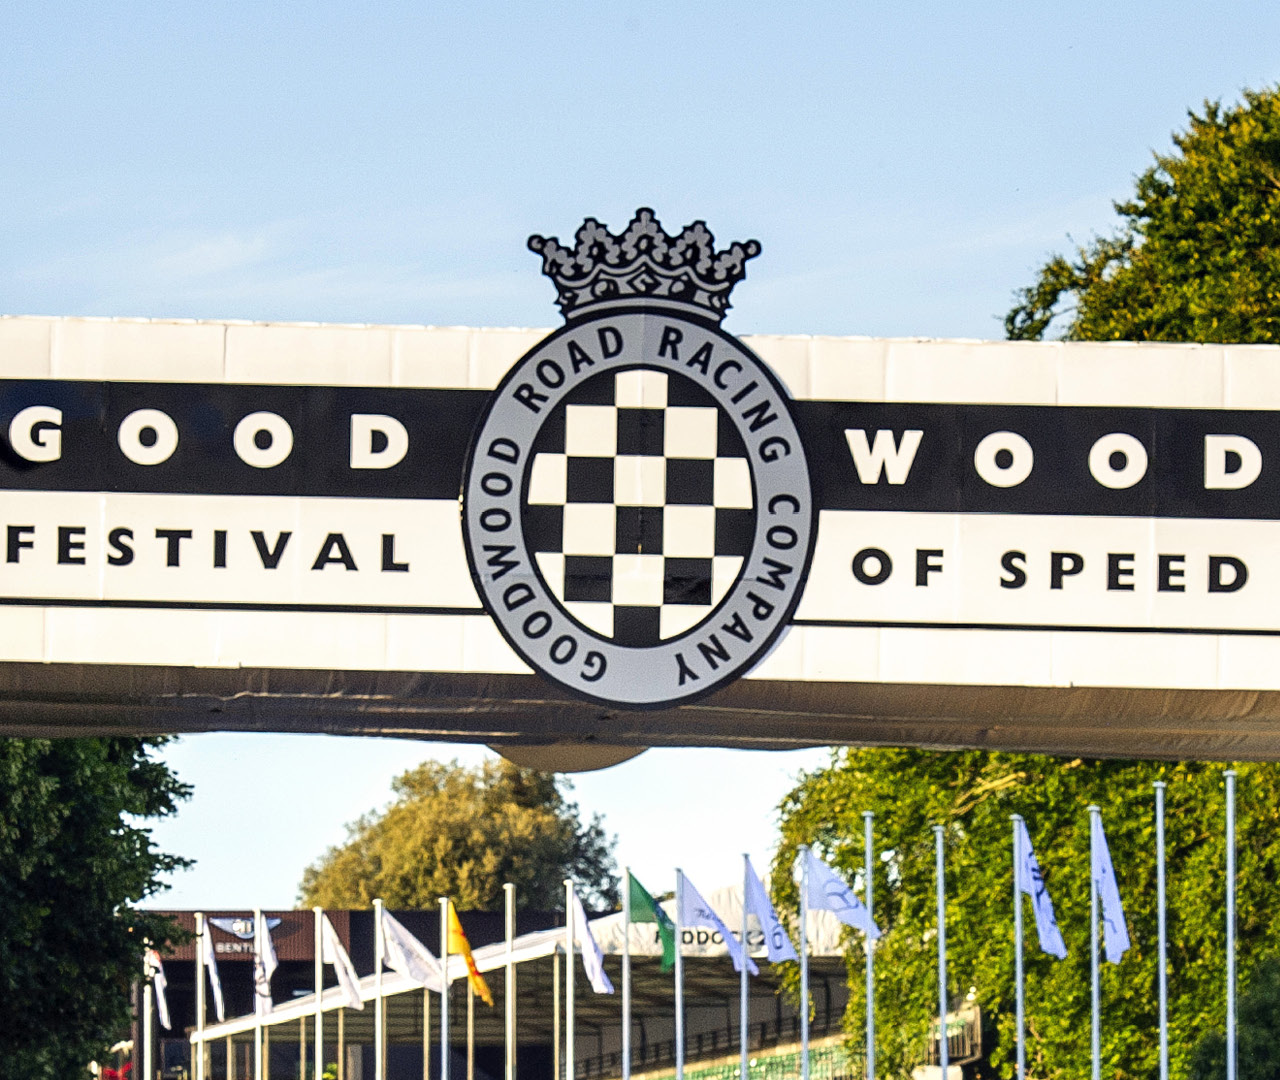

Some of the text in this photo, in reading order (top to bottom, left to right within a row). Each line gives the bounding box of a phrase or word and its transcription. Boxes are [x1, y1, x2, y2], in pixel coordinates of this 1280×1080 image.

[8, 405, 410, 470] GOOD
[844, 428, 1263, 490] WOOD
[479, 325, 801, 687] GOODWOOD ROAD RACING COMPANY
[6, 525, 410, 573] FESTIVAL
[851, 547, 1249, 593] OF SPEED
